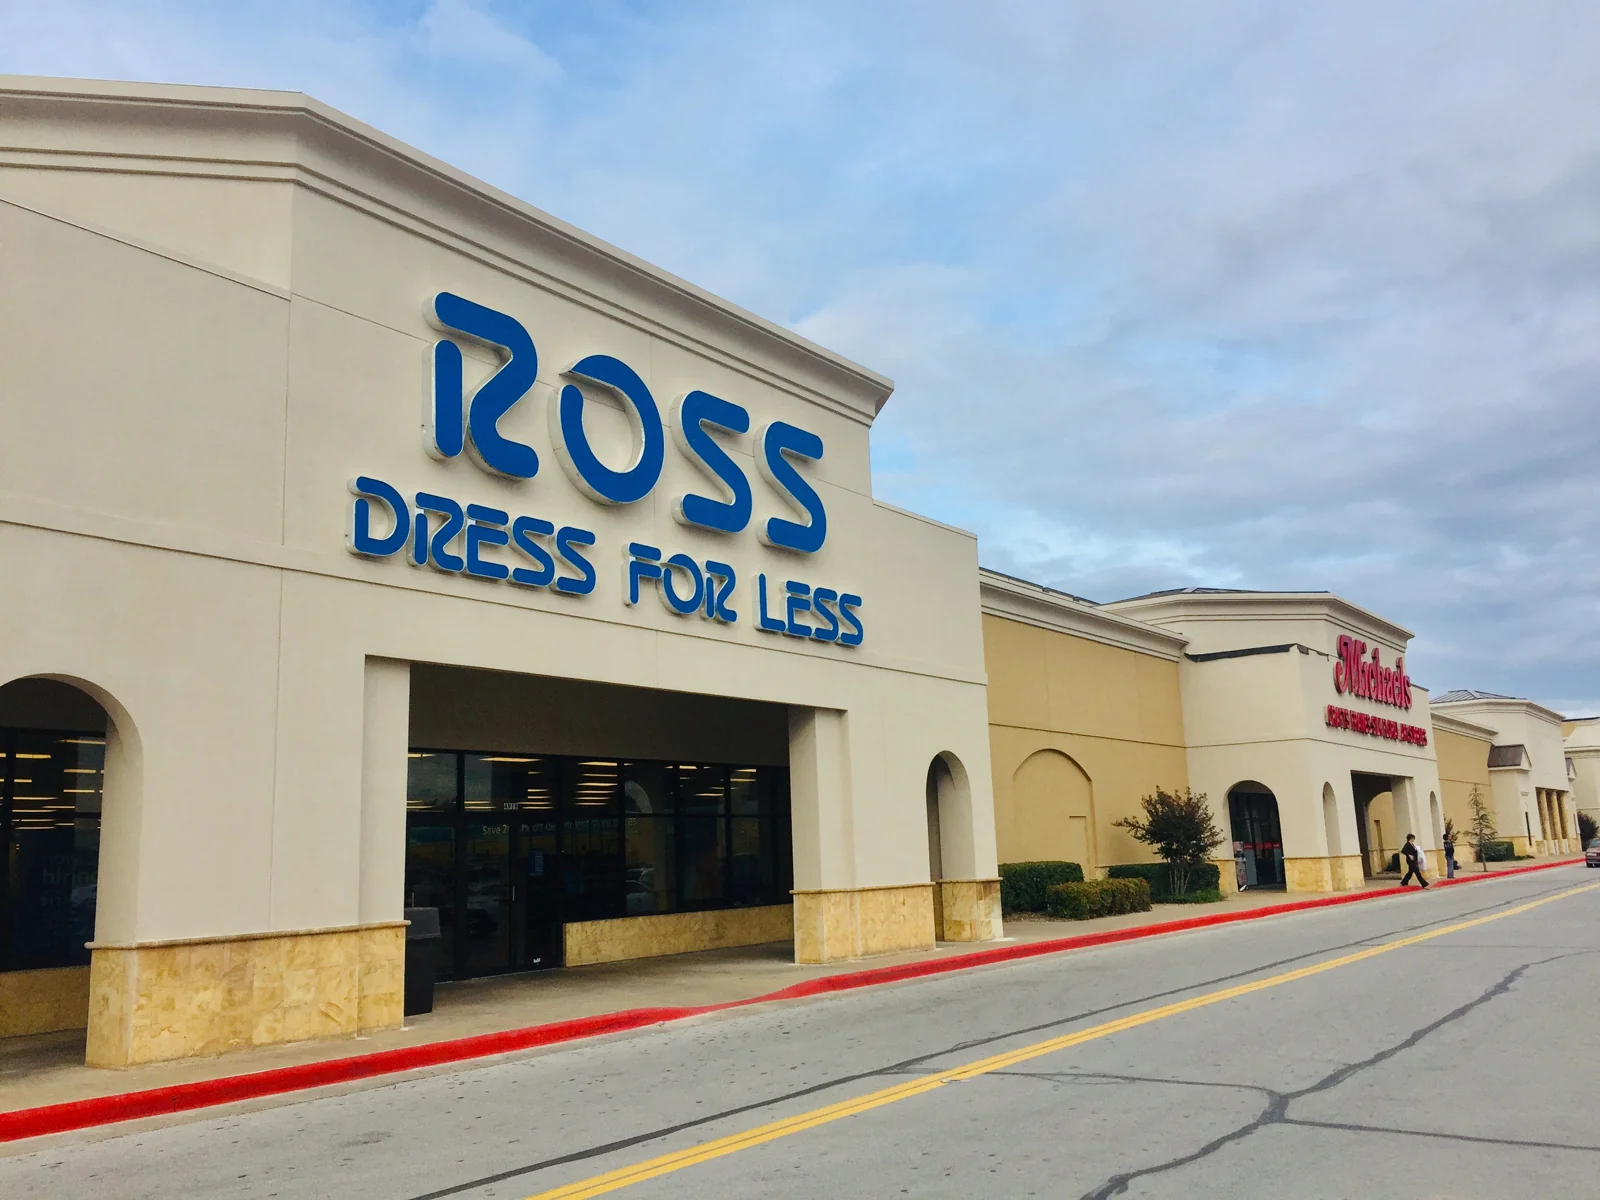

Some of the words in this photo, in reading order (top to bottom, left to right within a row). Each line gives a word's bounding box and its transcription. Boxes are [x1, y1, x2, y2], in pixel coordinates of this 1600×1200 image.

[428, 291, 827, 553] ROSS
[351, 475, 596, 595] DRESS
[626, 541, 737, 622] FOR
[755, 573, 864, 646] LESS
[1334, 635, 1412, 709] Michaels
[482, 824, 500, 836] Save
